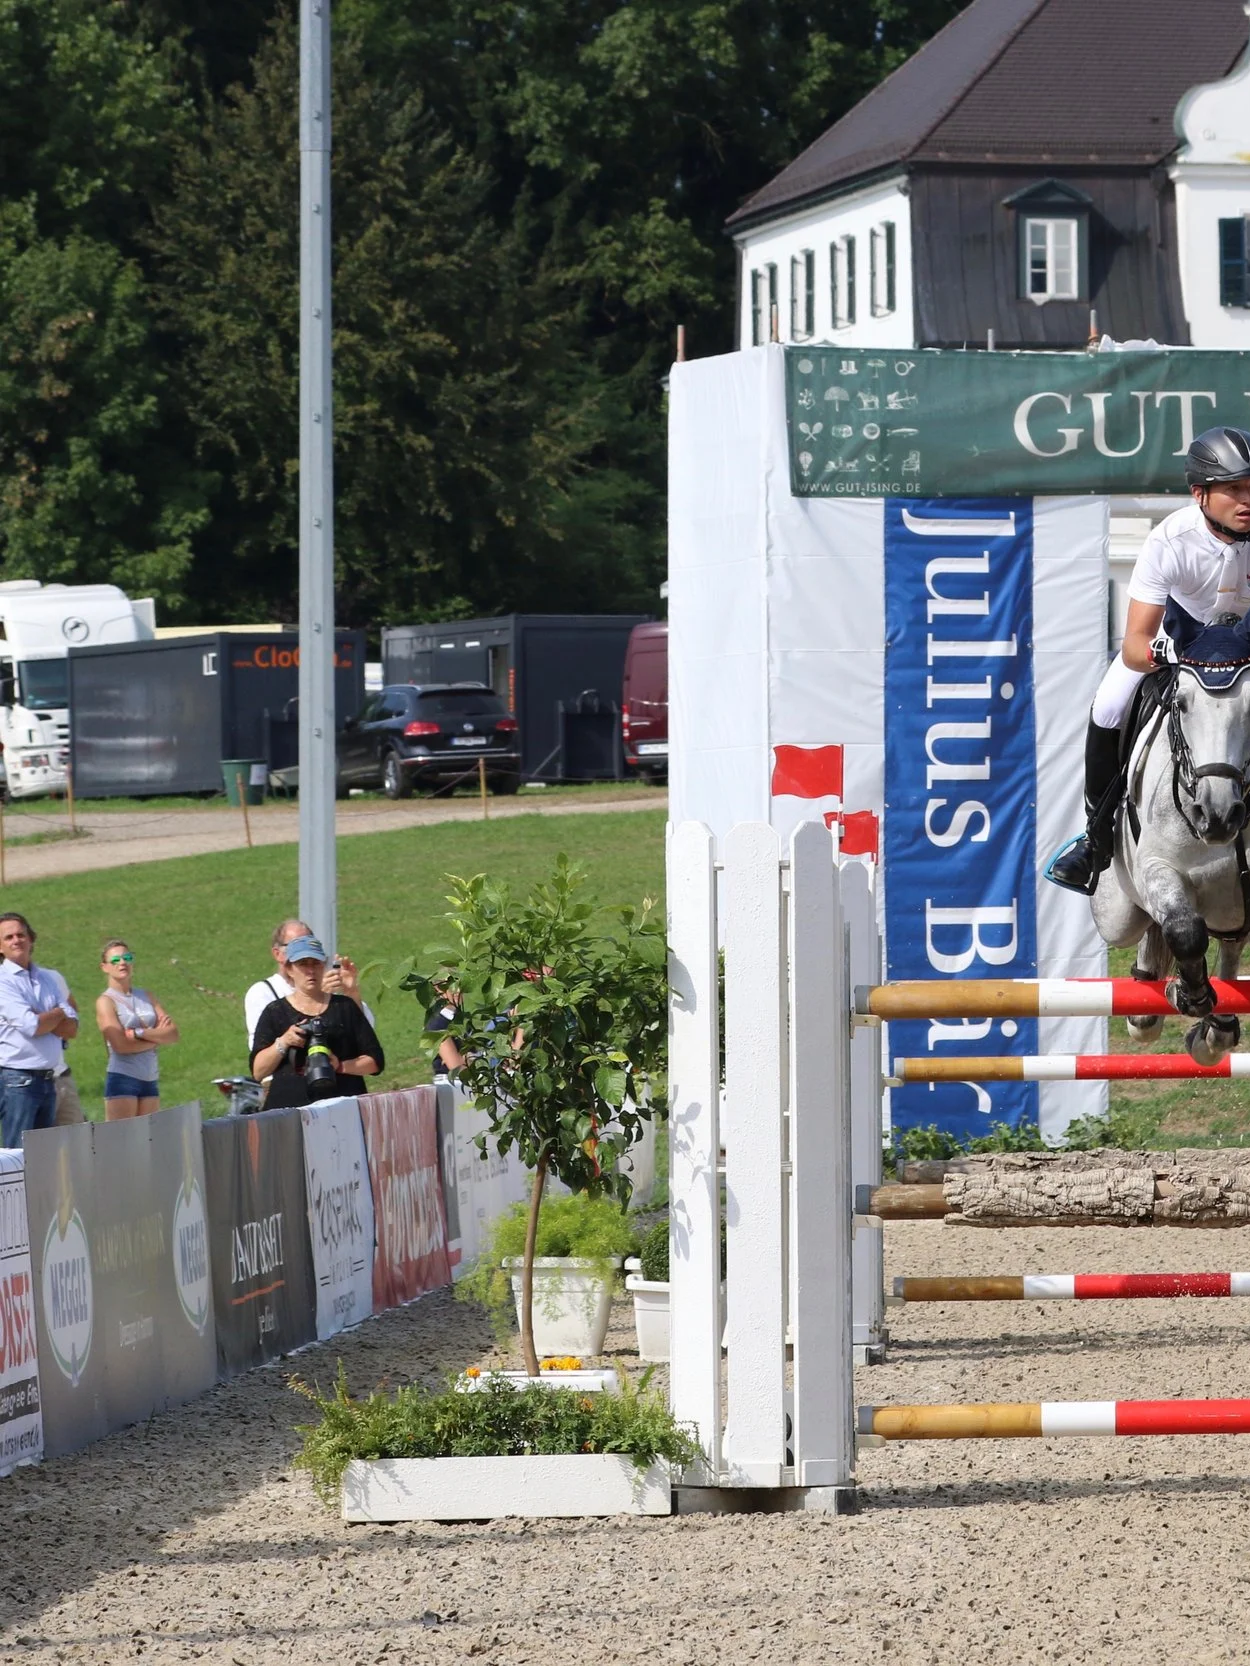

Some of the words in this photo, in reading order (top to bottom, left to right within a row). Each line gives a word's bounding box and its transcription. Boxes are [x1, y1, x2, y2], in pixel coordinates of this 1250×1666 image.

[1013, 391, 1217, 458] GUT
[799, 482, 921, 494] WWW.GUT-ISING.DE
[902, 509, 1017, 848] Julius
[1204, 665, 1235, 673] Pavo
[179, 1219, 208, 1287] MEGGLE
[49, 1256, 88, 1330] MEGGLE
